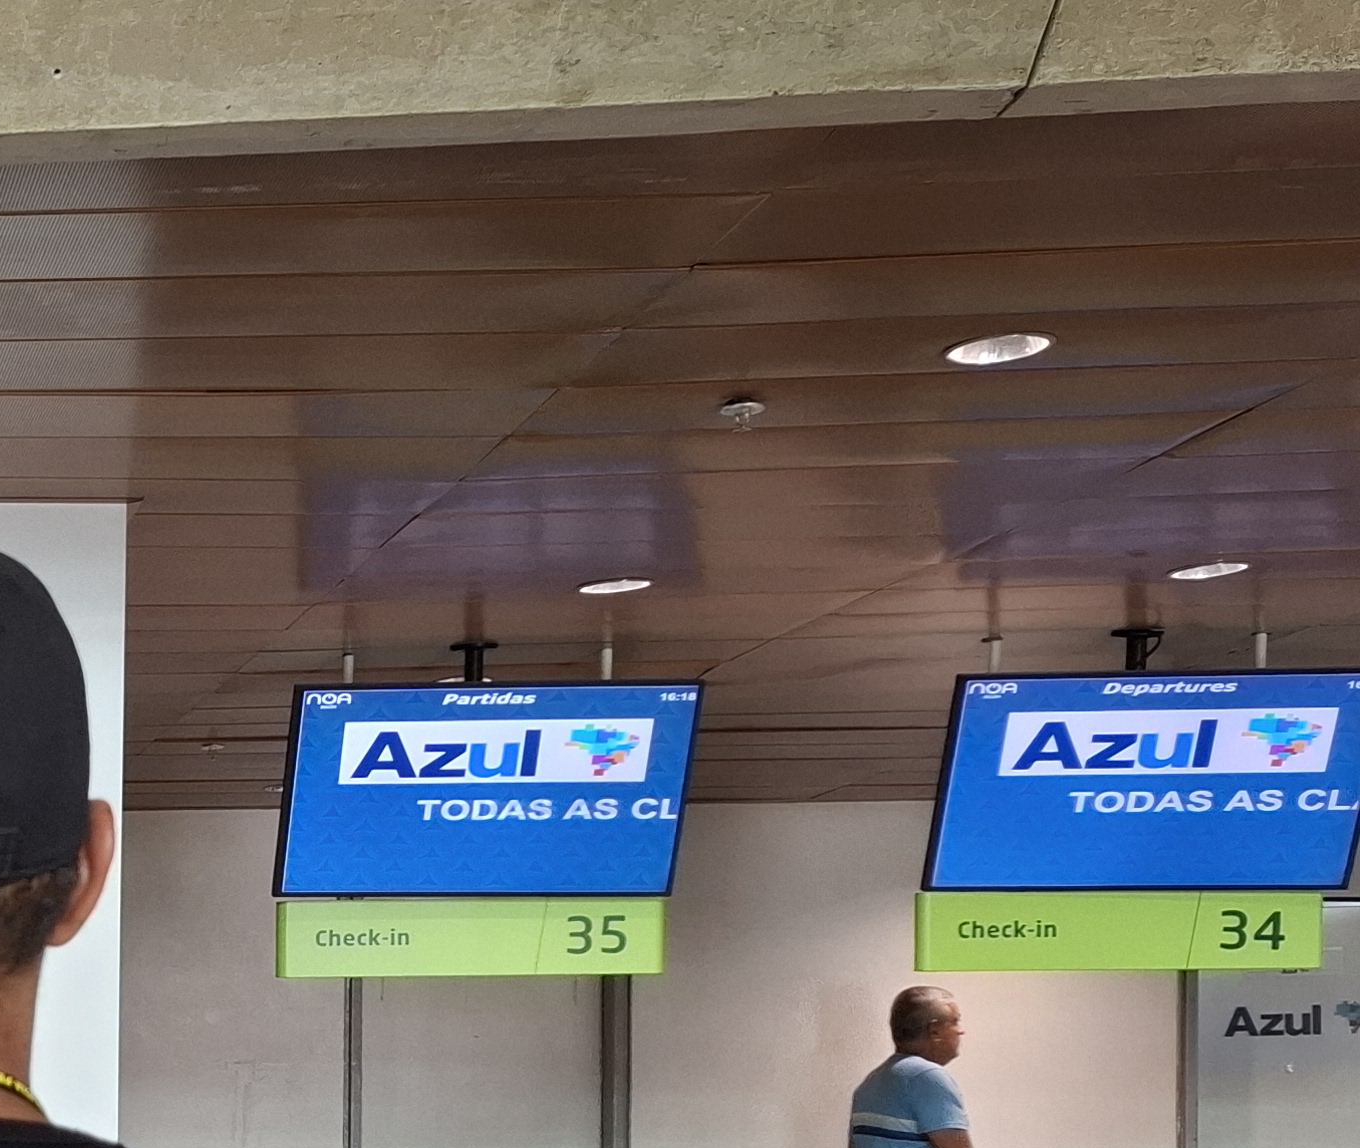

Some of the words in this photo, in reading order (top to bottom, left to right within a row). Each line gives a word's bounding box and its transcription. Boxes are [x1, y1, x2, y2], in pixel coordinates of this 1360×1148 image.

[442, 692, 536, 706] Partidas
[659, 692, 697, 702] 16:18
[1102, 681, 1238, 695] Departures
[350, 729, 542, 779] Azul
[1011, 719, 1218, 770] Azul
[417, 798, 552, 821] TODAS
[562, 798, 618, 820] AS
[1069, 790, 1213, 813] TODAS
[1223, 789, 1284, 812] AS
[315, 928, 410, 948] Check-in
[566, 914, 628, 955] 35
[958, 919, 1057, 939] Check-in
[1219, 910, 1286, 951] 34
[1224, 1005, 1322, 1037] Azul
